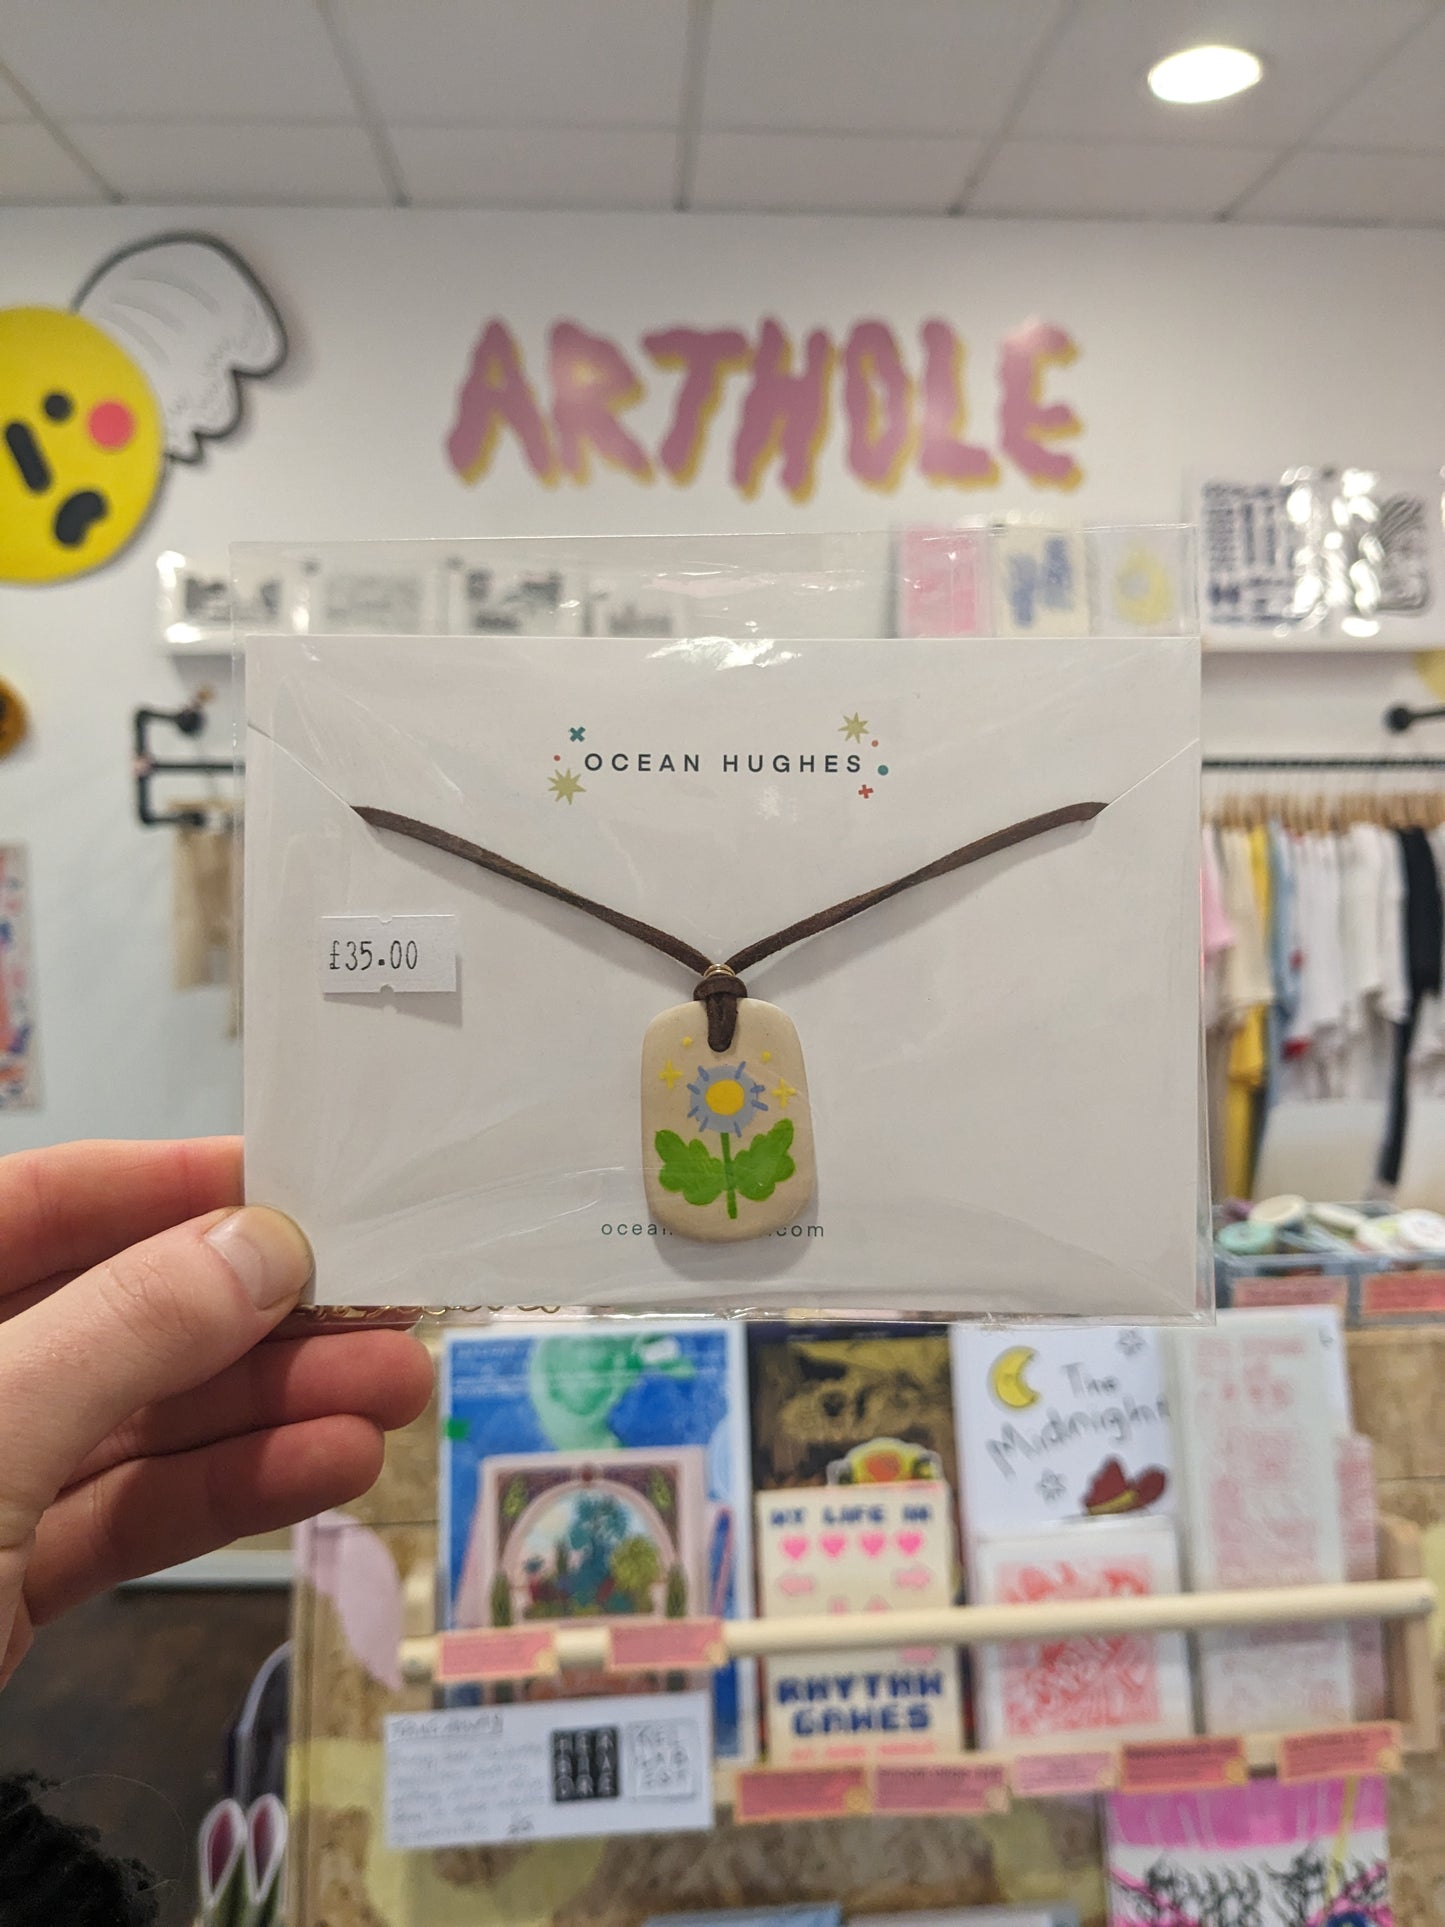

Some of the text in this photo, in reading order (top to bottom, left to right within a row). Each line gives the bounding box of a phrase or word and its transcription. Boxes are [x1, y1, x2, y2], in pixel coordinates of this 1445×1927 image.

[445, 318, 1084, 504] ARTHOLE
[584, 753, 861, 772] OCEAN HUGHES
[329, 940, 418, 971] £35.00
[1062, 1362, 1119, 1397] The
[777, 1670, 942, 1704] RHYTHM
[794, 1703, 928, 1735] GAMES
